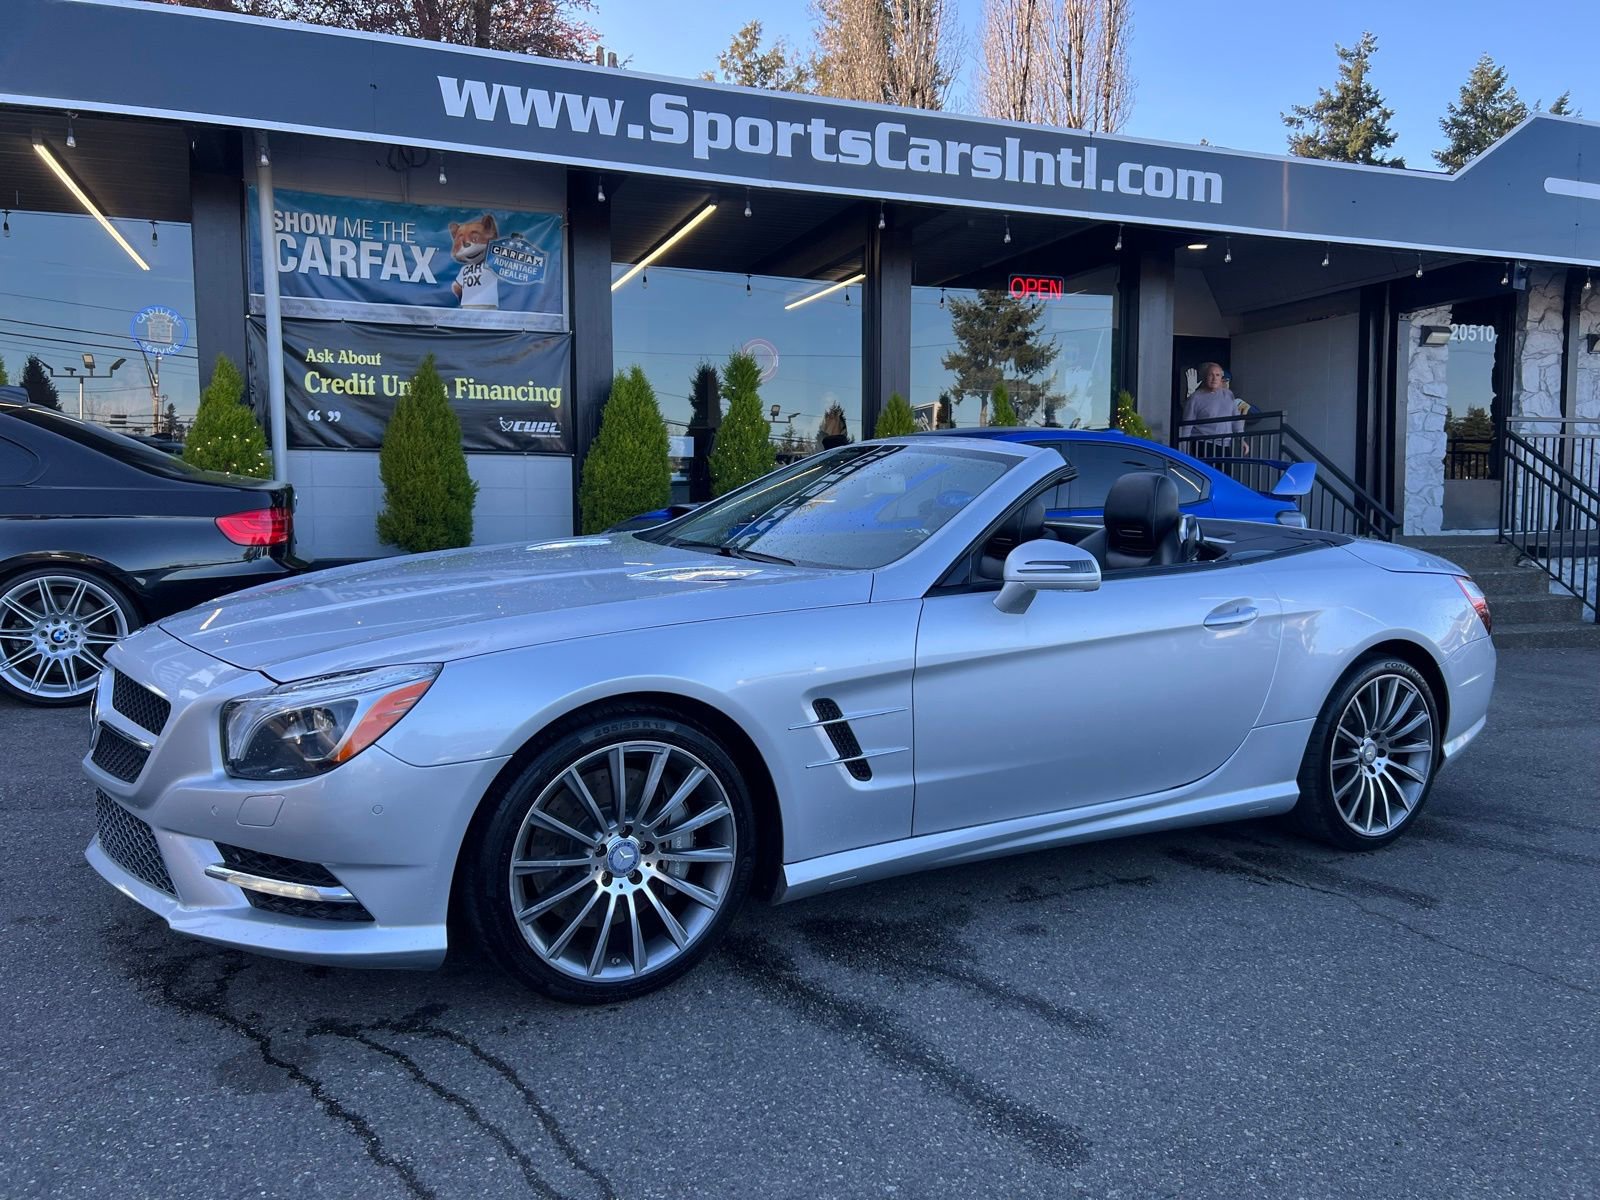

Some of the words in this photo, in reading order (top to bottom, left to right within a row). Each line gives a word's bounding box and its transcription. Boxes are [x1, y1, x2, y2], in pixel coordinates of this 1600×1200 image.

[437, 75, 1223, 205] www.SportsCarsIntl.com
[273, 209, 337, 236] SHOW
[343, 217, 374, 240] ME
[380, 220, 416, 244] THE
[275, 232, 438, 285] CARFAX
[492, 245, 544, 268] CARFAX
[463, 263, 482, 276] CAR
[493, 257, 538, 276] ADVANTAGE
[498, 267, 529, 283] DEALER
[463, 274, 482, 288] FOX
[1010, 277, 1062, 300] OPEN
[136, 307, 182, 327] CADILLAC
[1450, 323, 1495, 342] 20510
[142, 342, 180, 354] SERVICE
[305, 347, 335, 364] Ask
[337, 349, 382, 366] About
[304, 370, 376, 397] Credit
[455, 377, 562, 409] Financing
